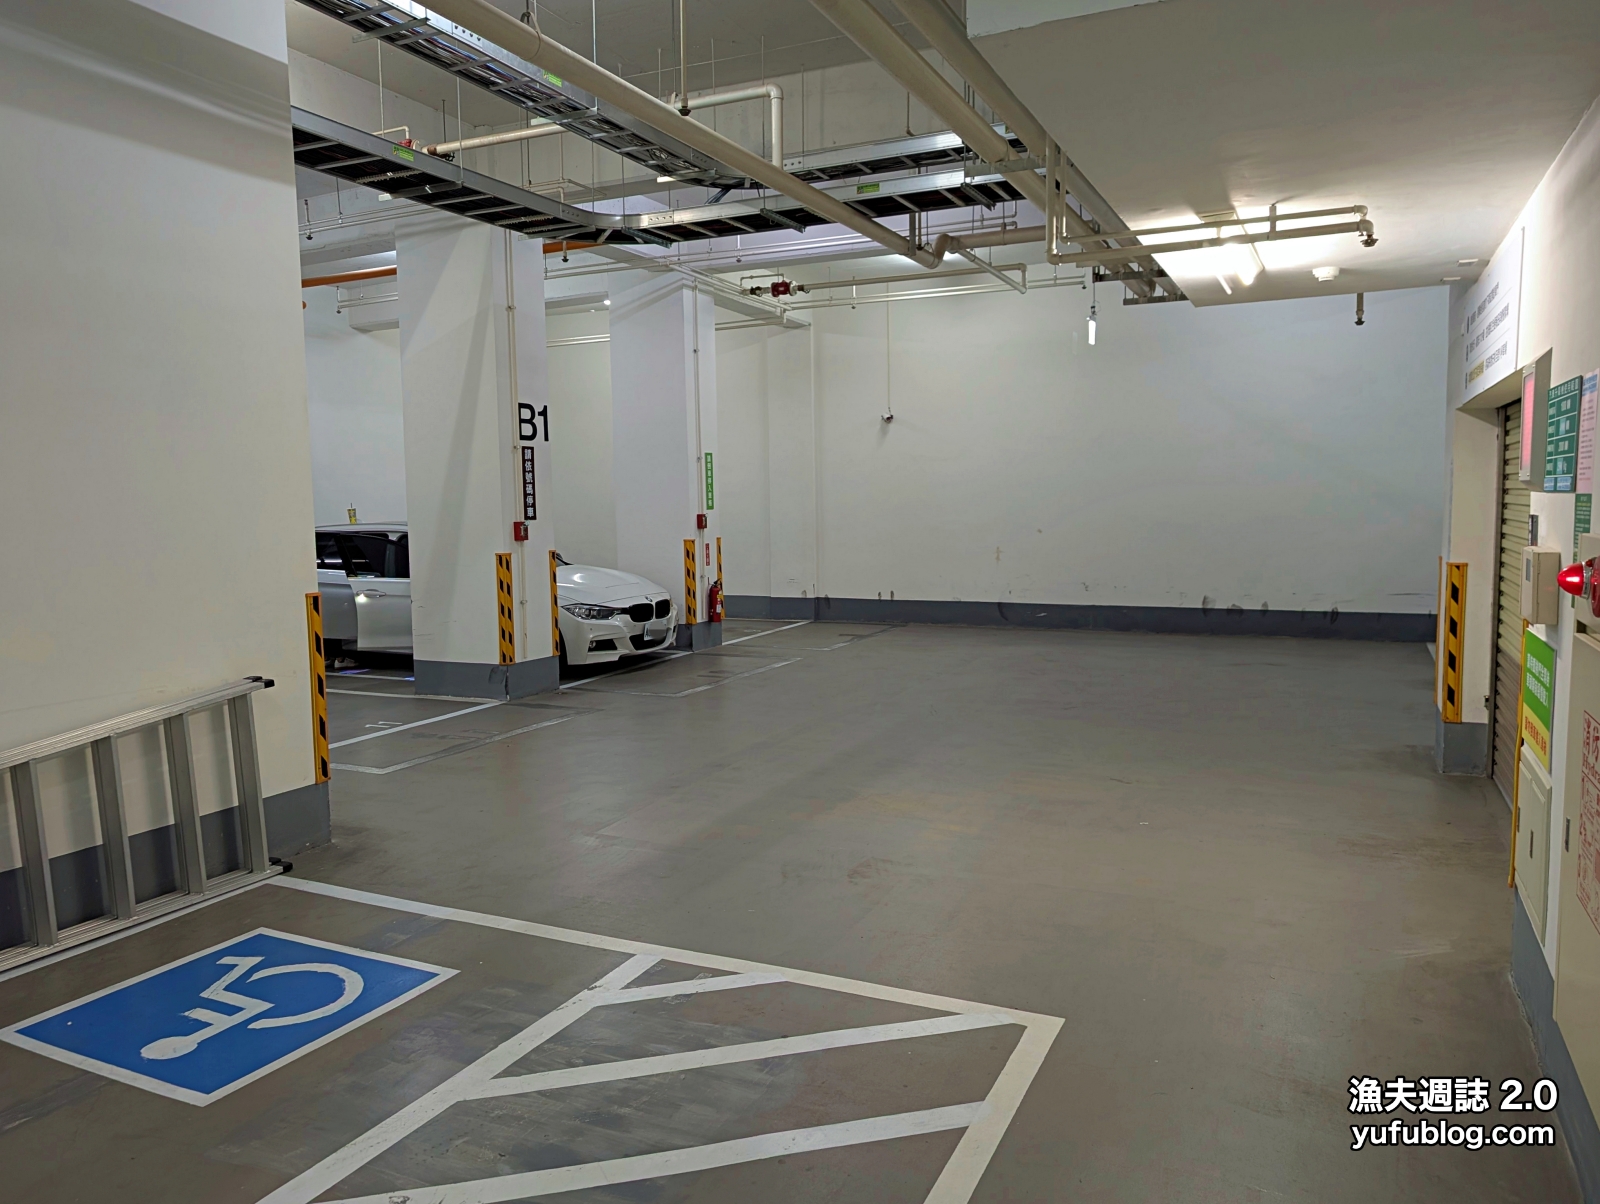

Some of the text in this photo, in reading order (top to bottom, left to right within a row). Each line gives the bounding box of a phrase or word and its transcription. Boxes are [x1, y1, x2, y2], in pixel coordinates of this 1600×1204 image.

[518, 402, 549, 442] B1
[524, 448, 535, 518] 請依號碼停車
